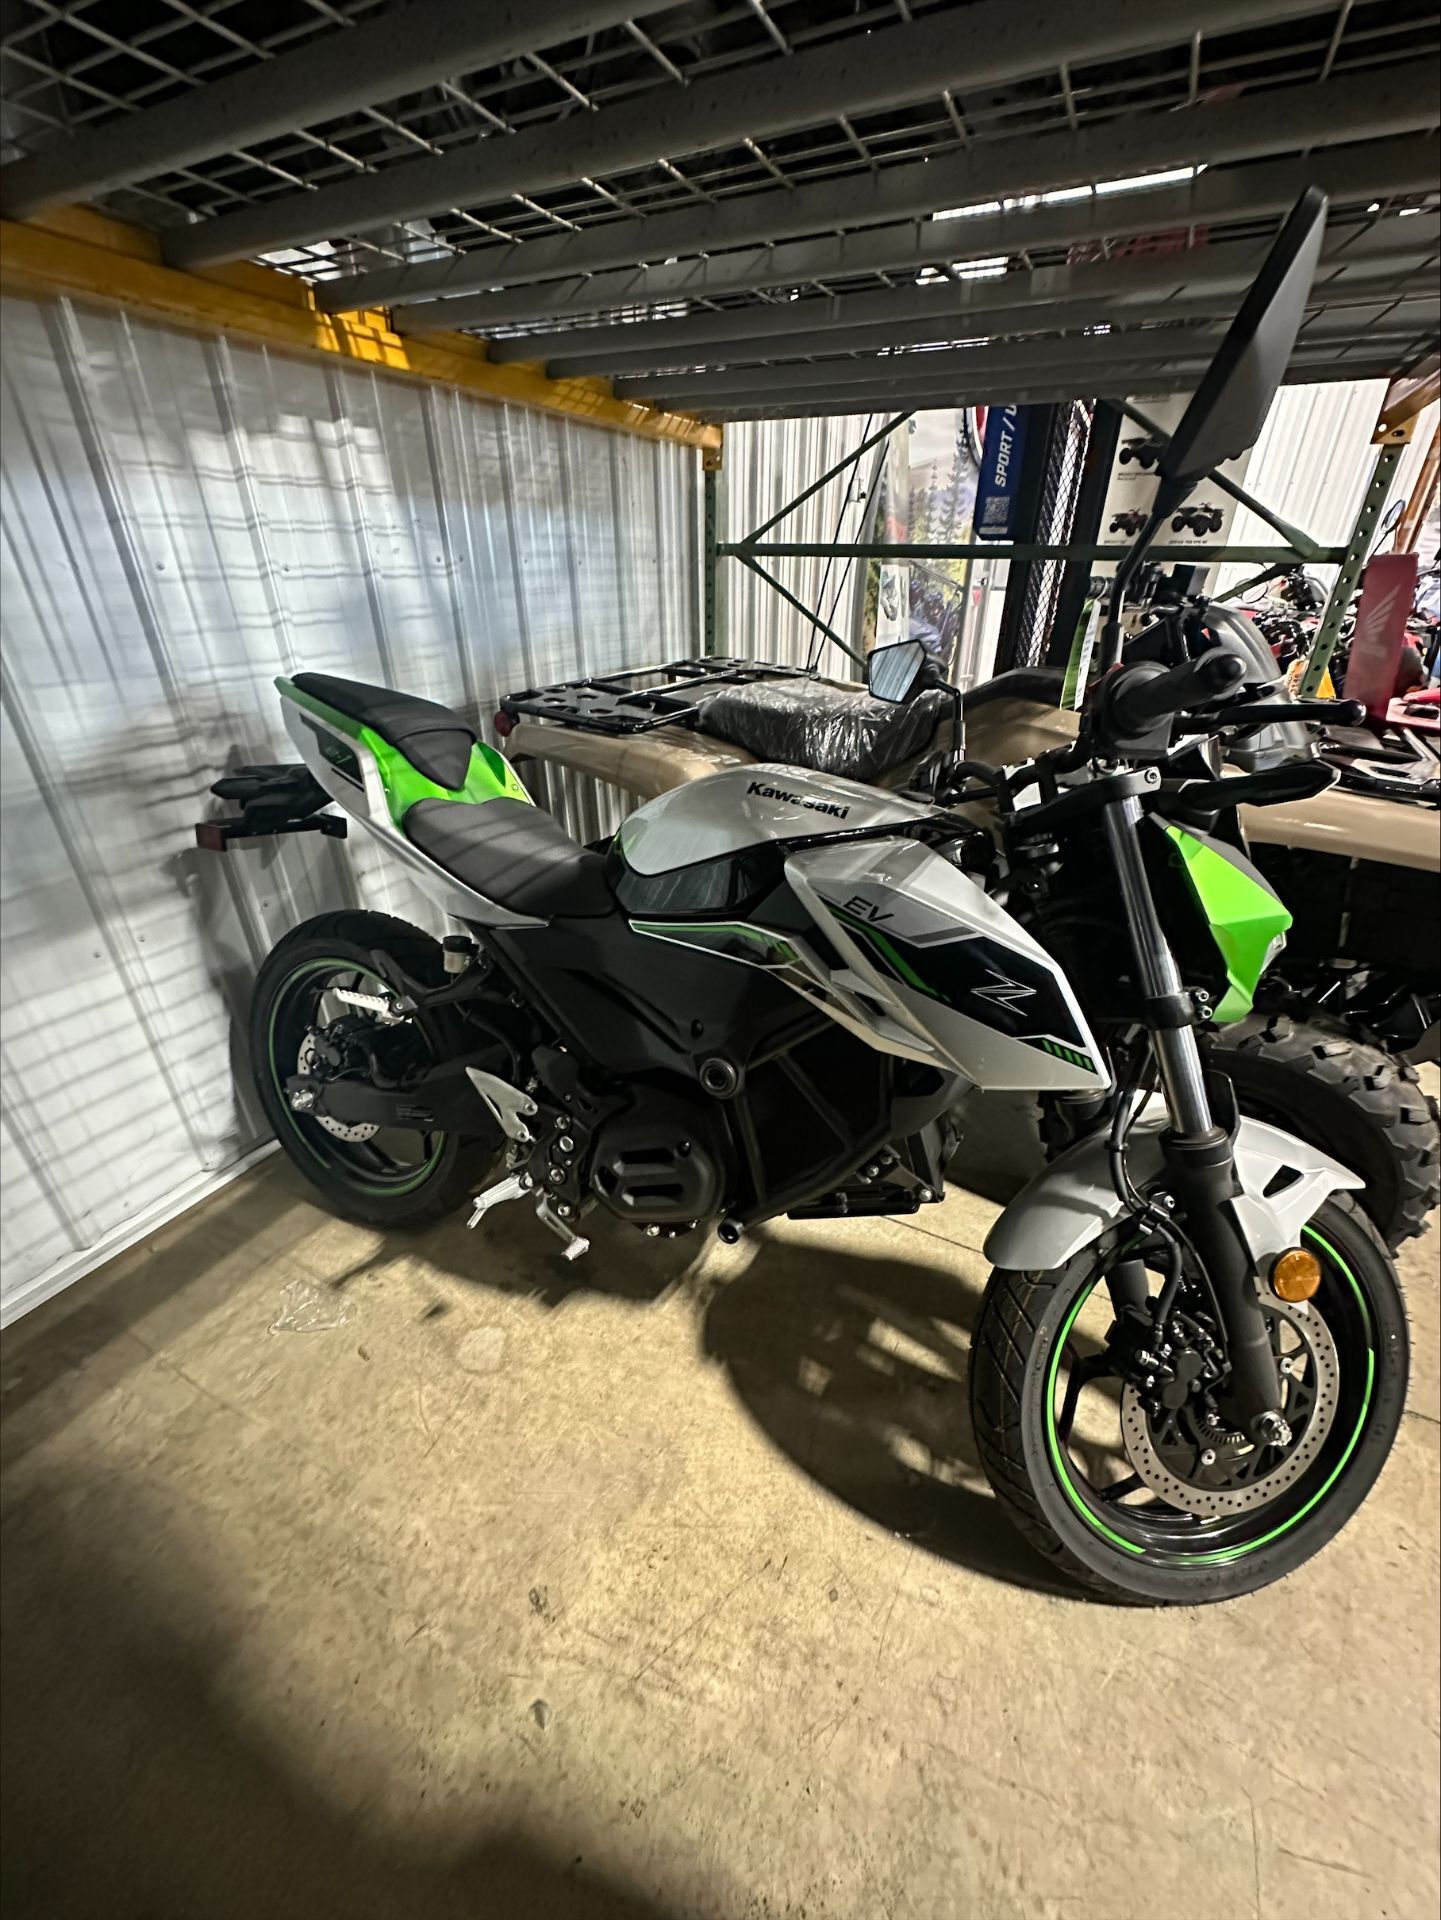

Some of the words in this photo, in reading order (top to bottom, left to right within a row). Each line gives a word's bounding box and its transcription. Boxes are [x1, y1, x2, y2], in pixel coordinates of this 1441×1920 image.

[995, 431, 1013, 488] SPORT
[747, 782, 850, 819] Kawasaki
[843, 895, 896, 922] EV
